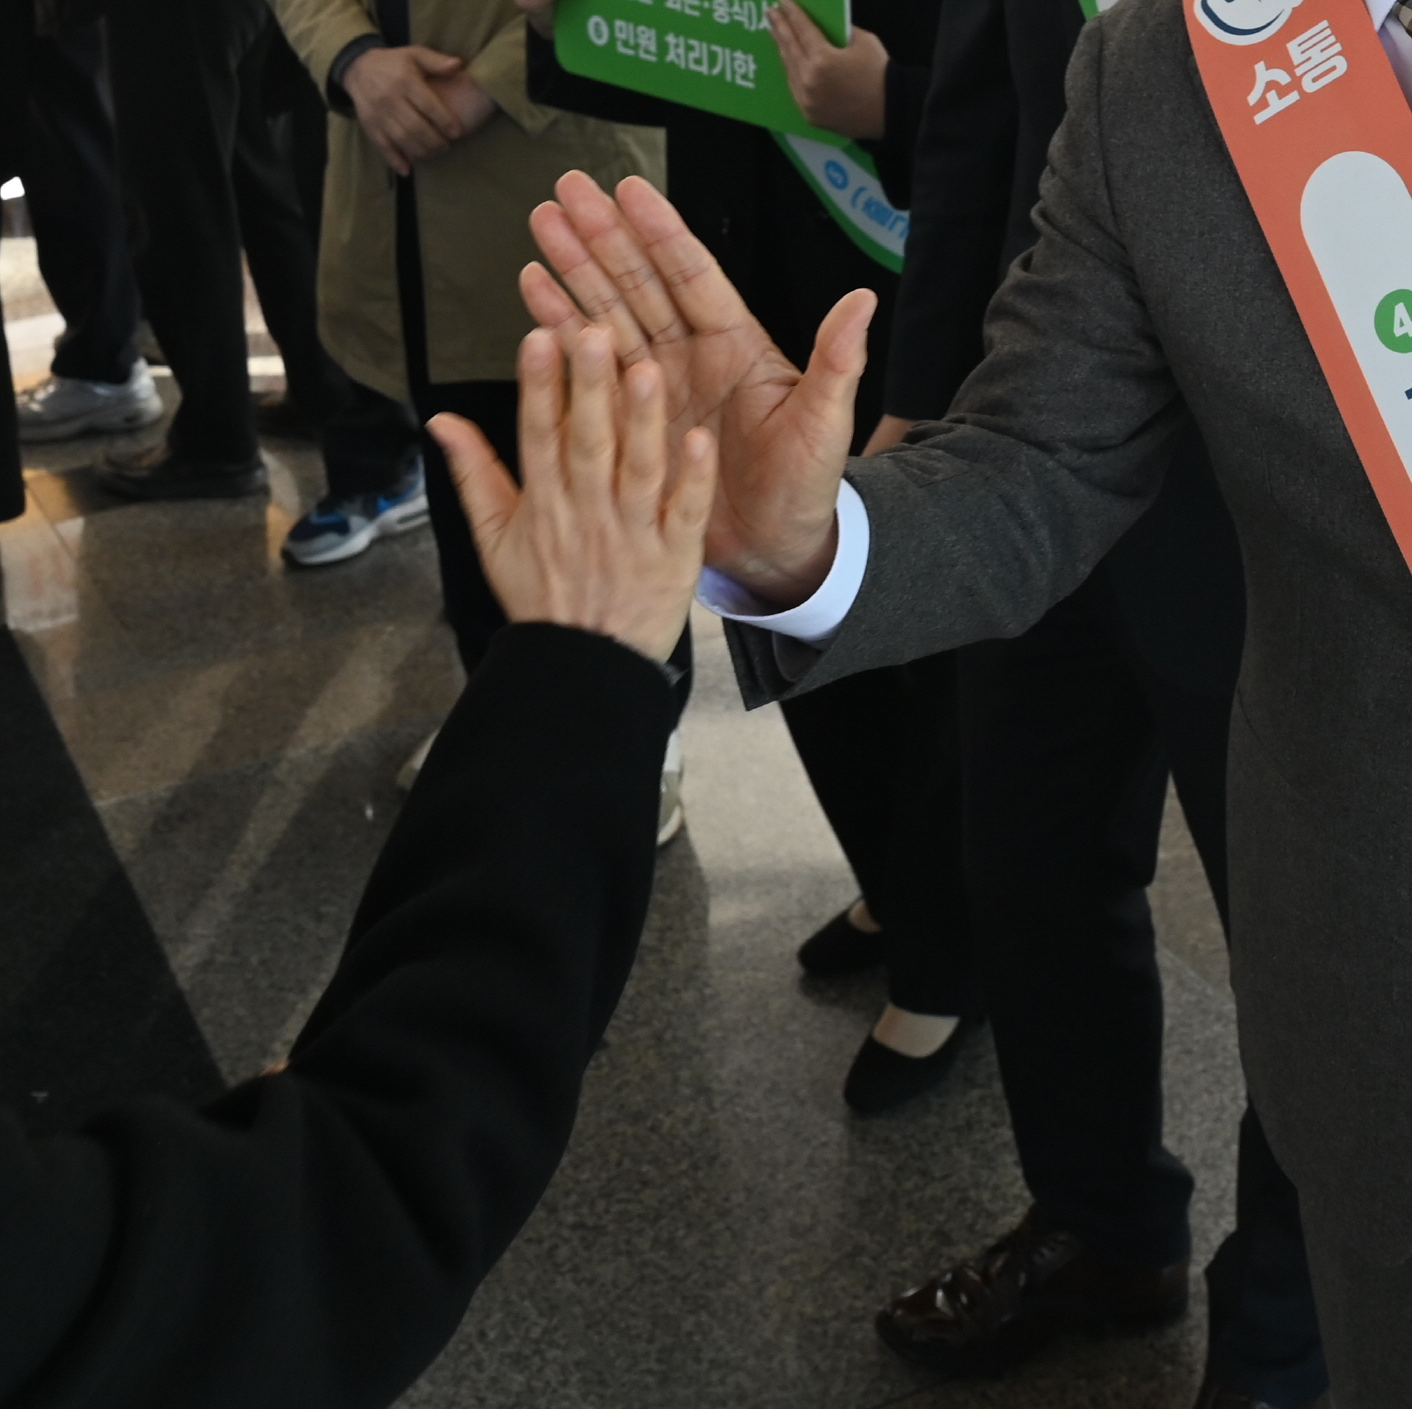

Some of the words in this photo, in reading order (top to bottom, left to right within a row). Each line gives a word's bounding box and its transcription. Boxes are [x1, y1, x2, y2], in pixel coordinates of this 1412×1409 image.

[614, 18, 659, 64] 민원
[664, 32, 758, 90] 처리기한
[1246, 18, 1351, 125] 소통
